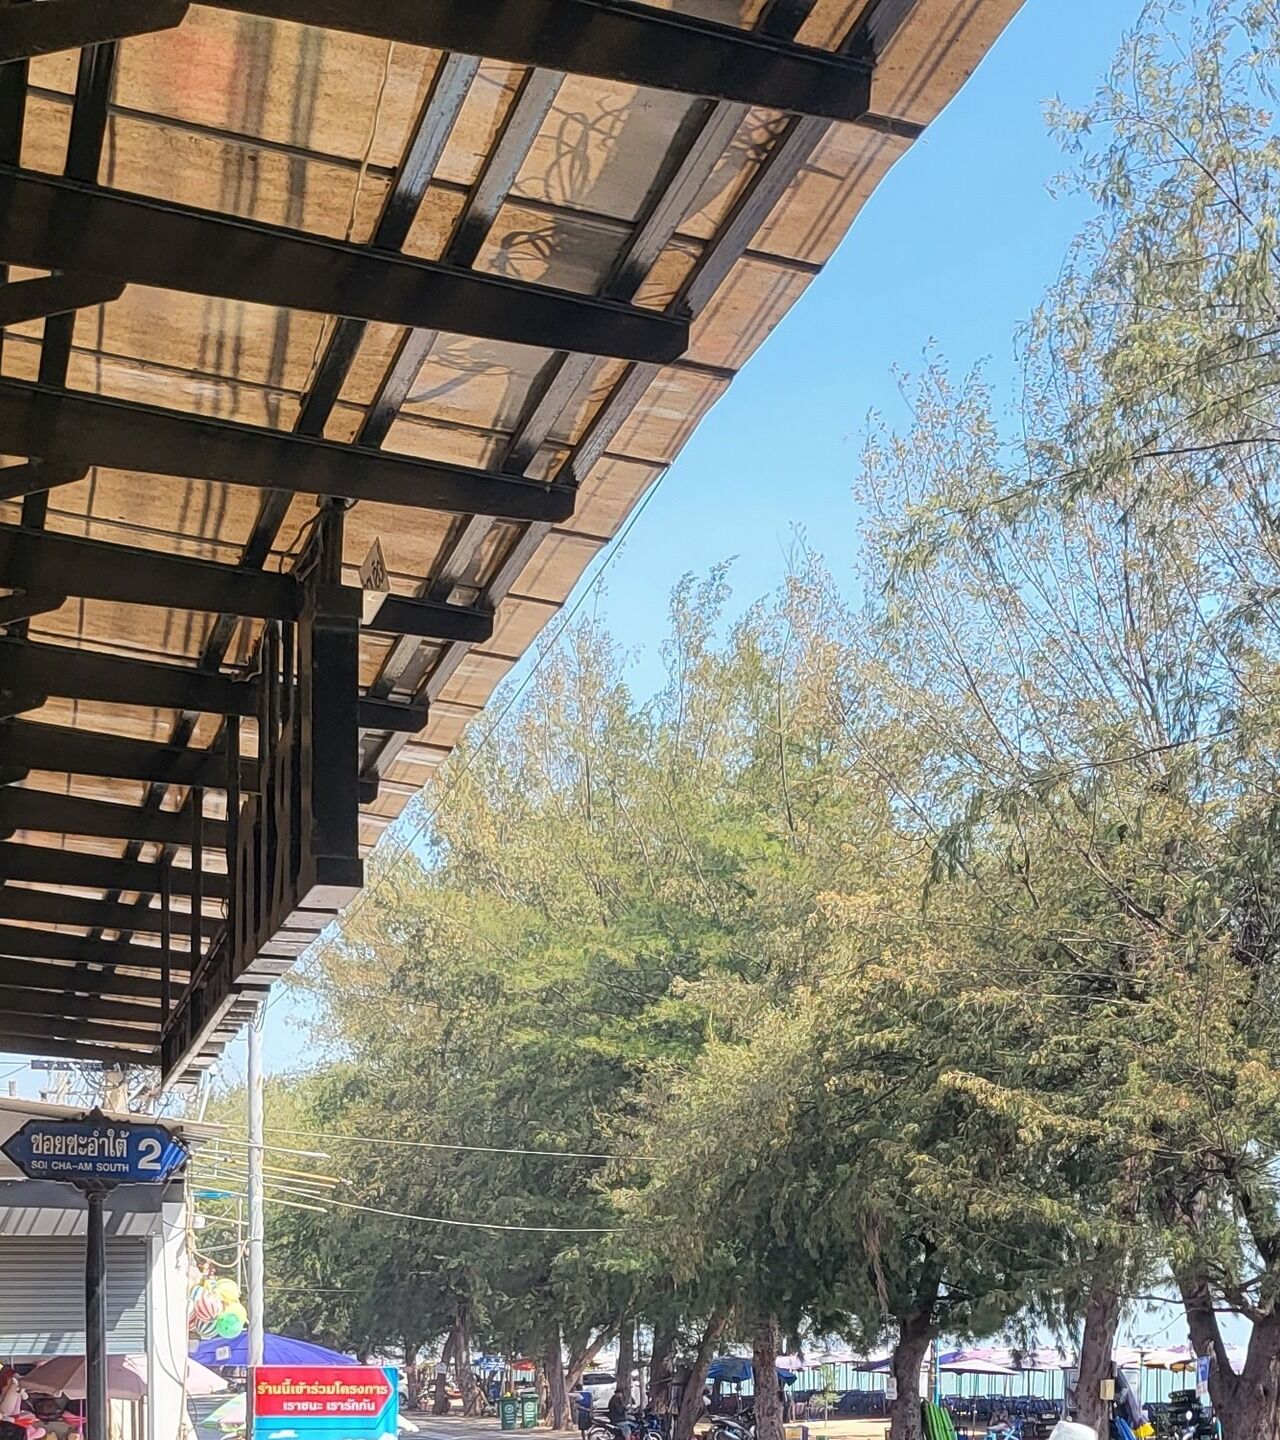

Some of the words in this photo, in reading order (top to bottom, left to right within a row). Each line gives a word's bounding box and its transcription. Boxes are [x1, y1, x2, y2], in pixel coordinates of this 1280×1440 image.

[30, 1128, 130, 1158] ซอยชะอำใต้
[137, 1138, 162, 1170] 2
[30, 1160, 48, 1170] SOI
[51, 1161, 93, 1171] CHA-AM
[96, 1162, 130, 1173] SOUTH
